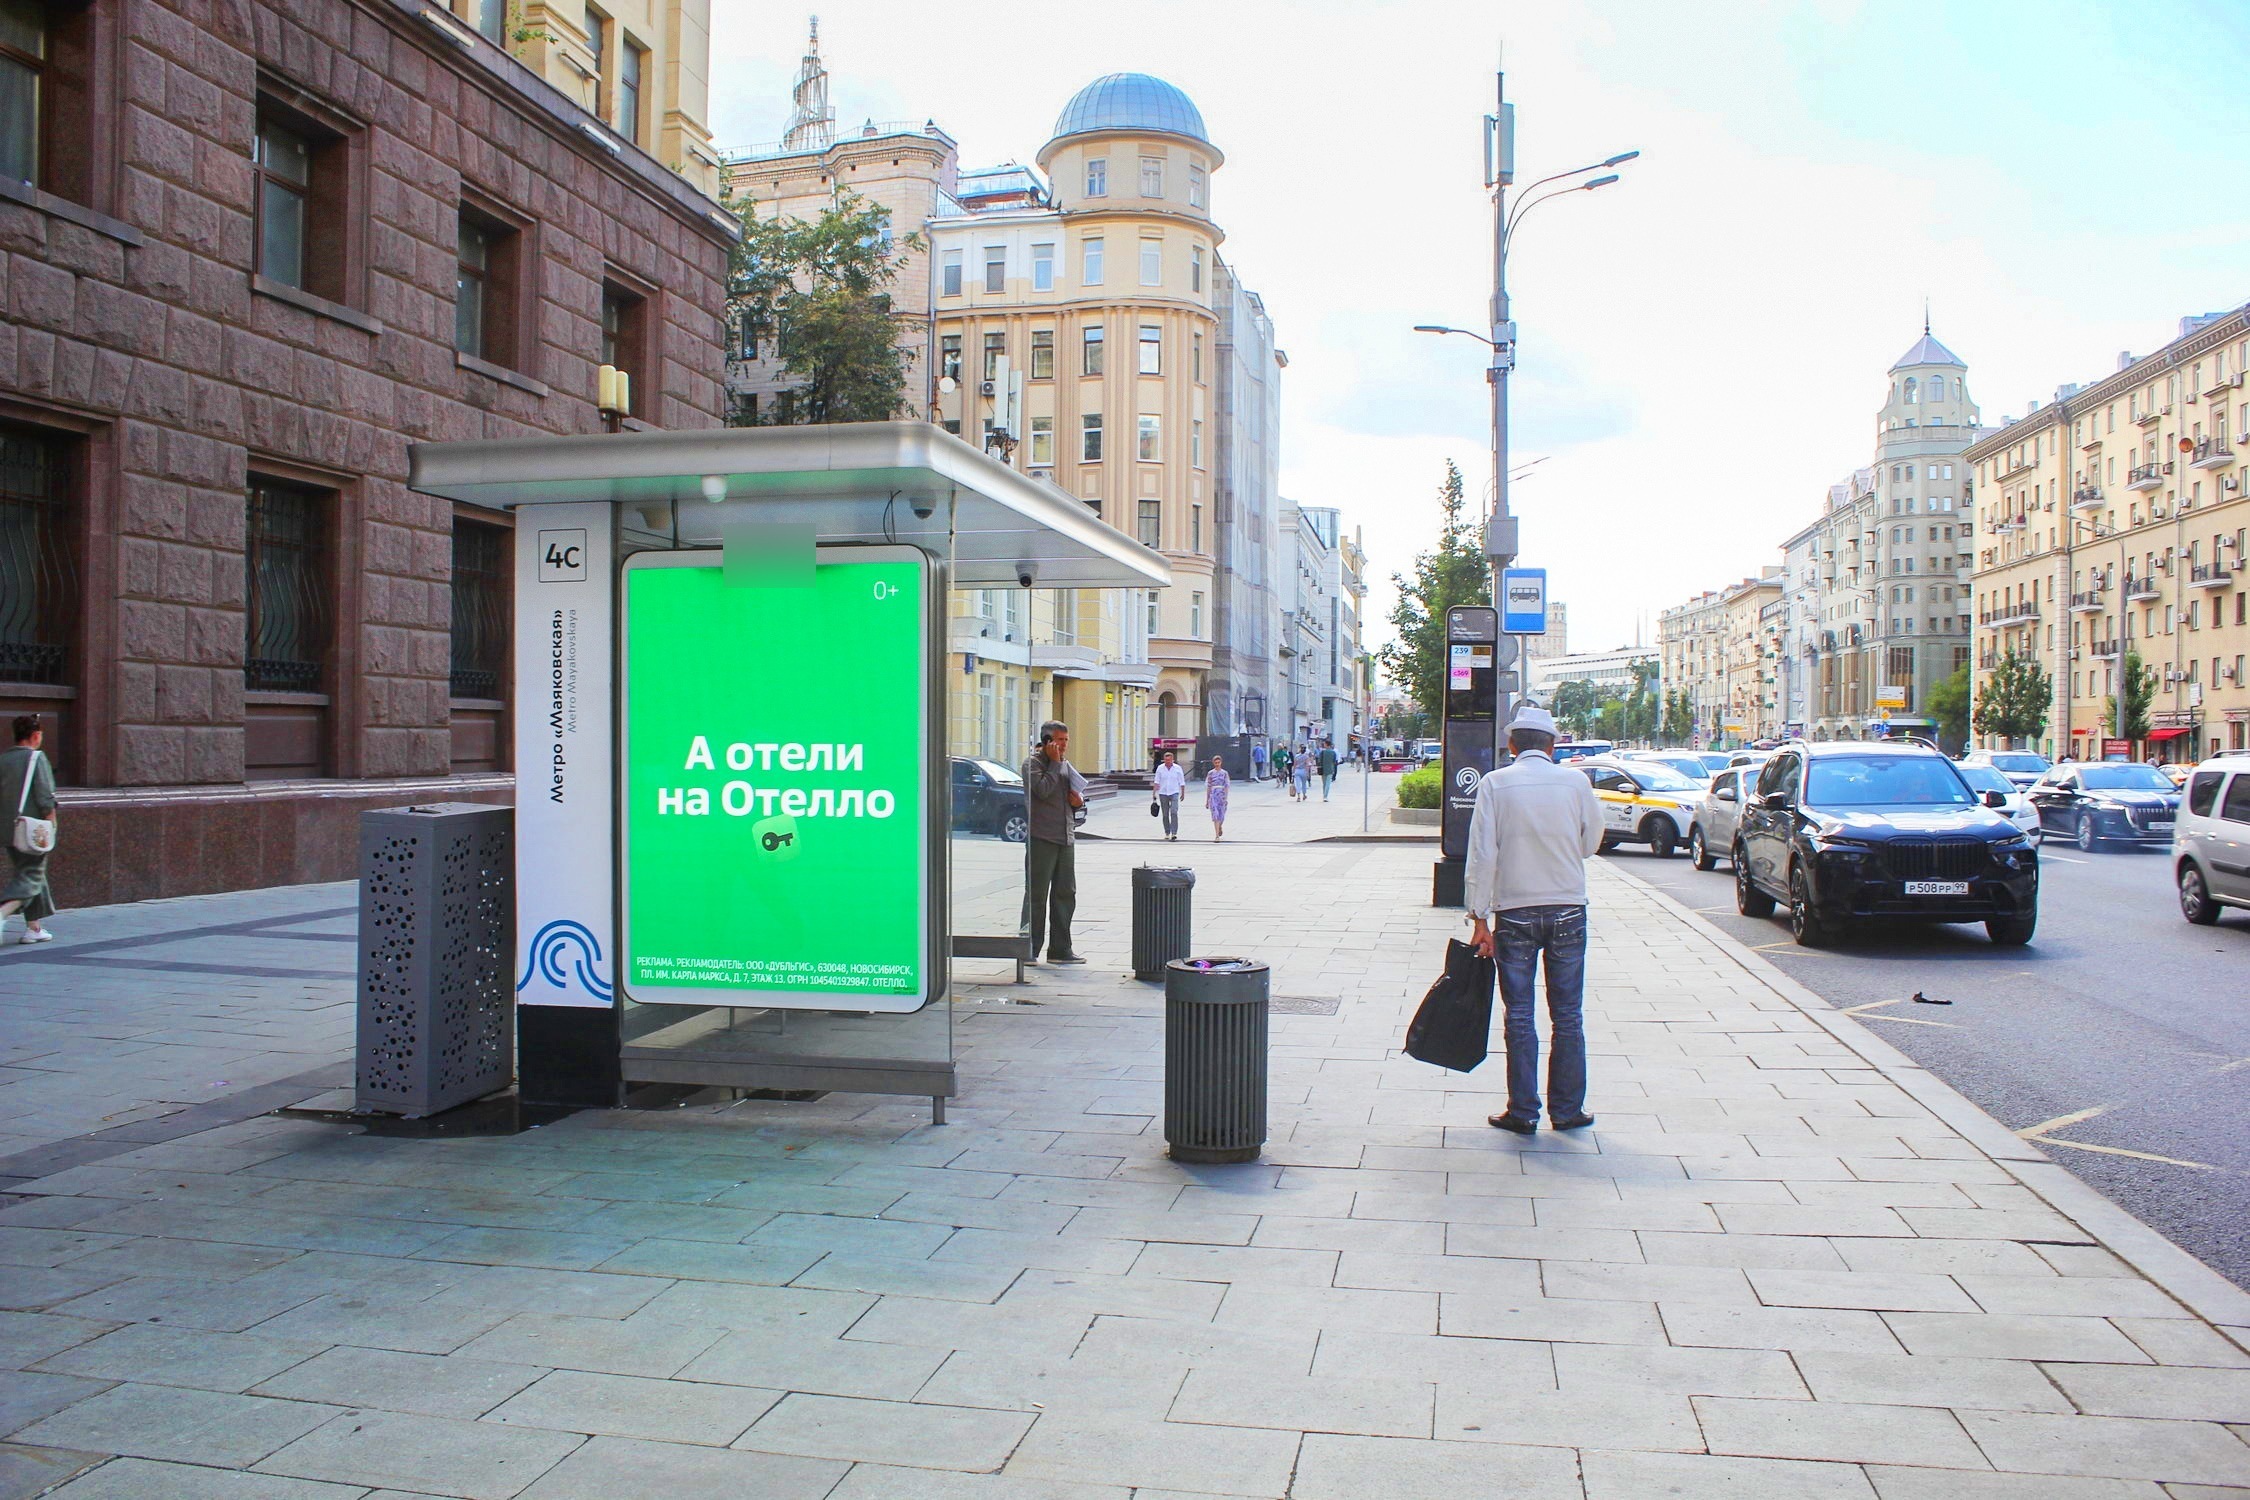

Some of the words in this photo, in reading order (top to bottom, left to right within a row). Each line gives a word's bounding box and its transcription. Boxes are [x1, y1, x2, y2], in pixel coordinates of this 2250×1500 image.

[873, 581, 899, 600] 0+
[567, 609, 577, 693] Mayakovskaya
[550, 610, 563, 738] «Маяковская»
[567, 696, 577, 733] Metro
[684, 735, 716, 770] А
[726, 742, 863, 771] отели
[550, 743, 566, 803] Метро
[658, 787, 710, 815] на
[721, 780, 895, 818] Отелло
[637, 957, 675, 967] РЕКЛАМА.
[677, 958, 744, 969] РЕКЛАМОДАТЕЛЬ:
[746, 960, 764, 970] ООО
[765, 961, 817, 973] «ДУБЛЬГИС»,
[818, 963, 849, 974] 630048,
[850, 964, 914, 976] НОВОСИБИРСК,
[641, 969, 654, 979] ПЛ.
[656, 970, 670, 979] ИМ.
[672, 970, 697, 980] КАРЛА
[699, 971, 732, 983] МАРКСА,
[733, 973, 741, 983] Д.
[743, 973, 750, 983] 7,
[751, 973, 773, 983] ЭТАЖ
[774, 974, 786, 984] 13.
[787, 975, 808, 985] ОГРН
[872, 977, 908, 988] ОТЕЛЛО.
